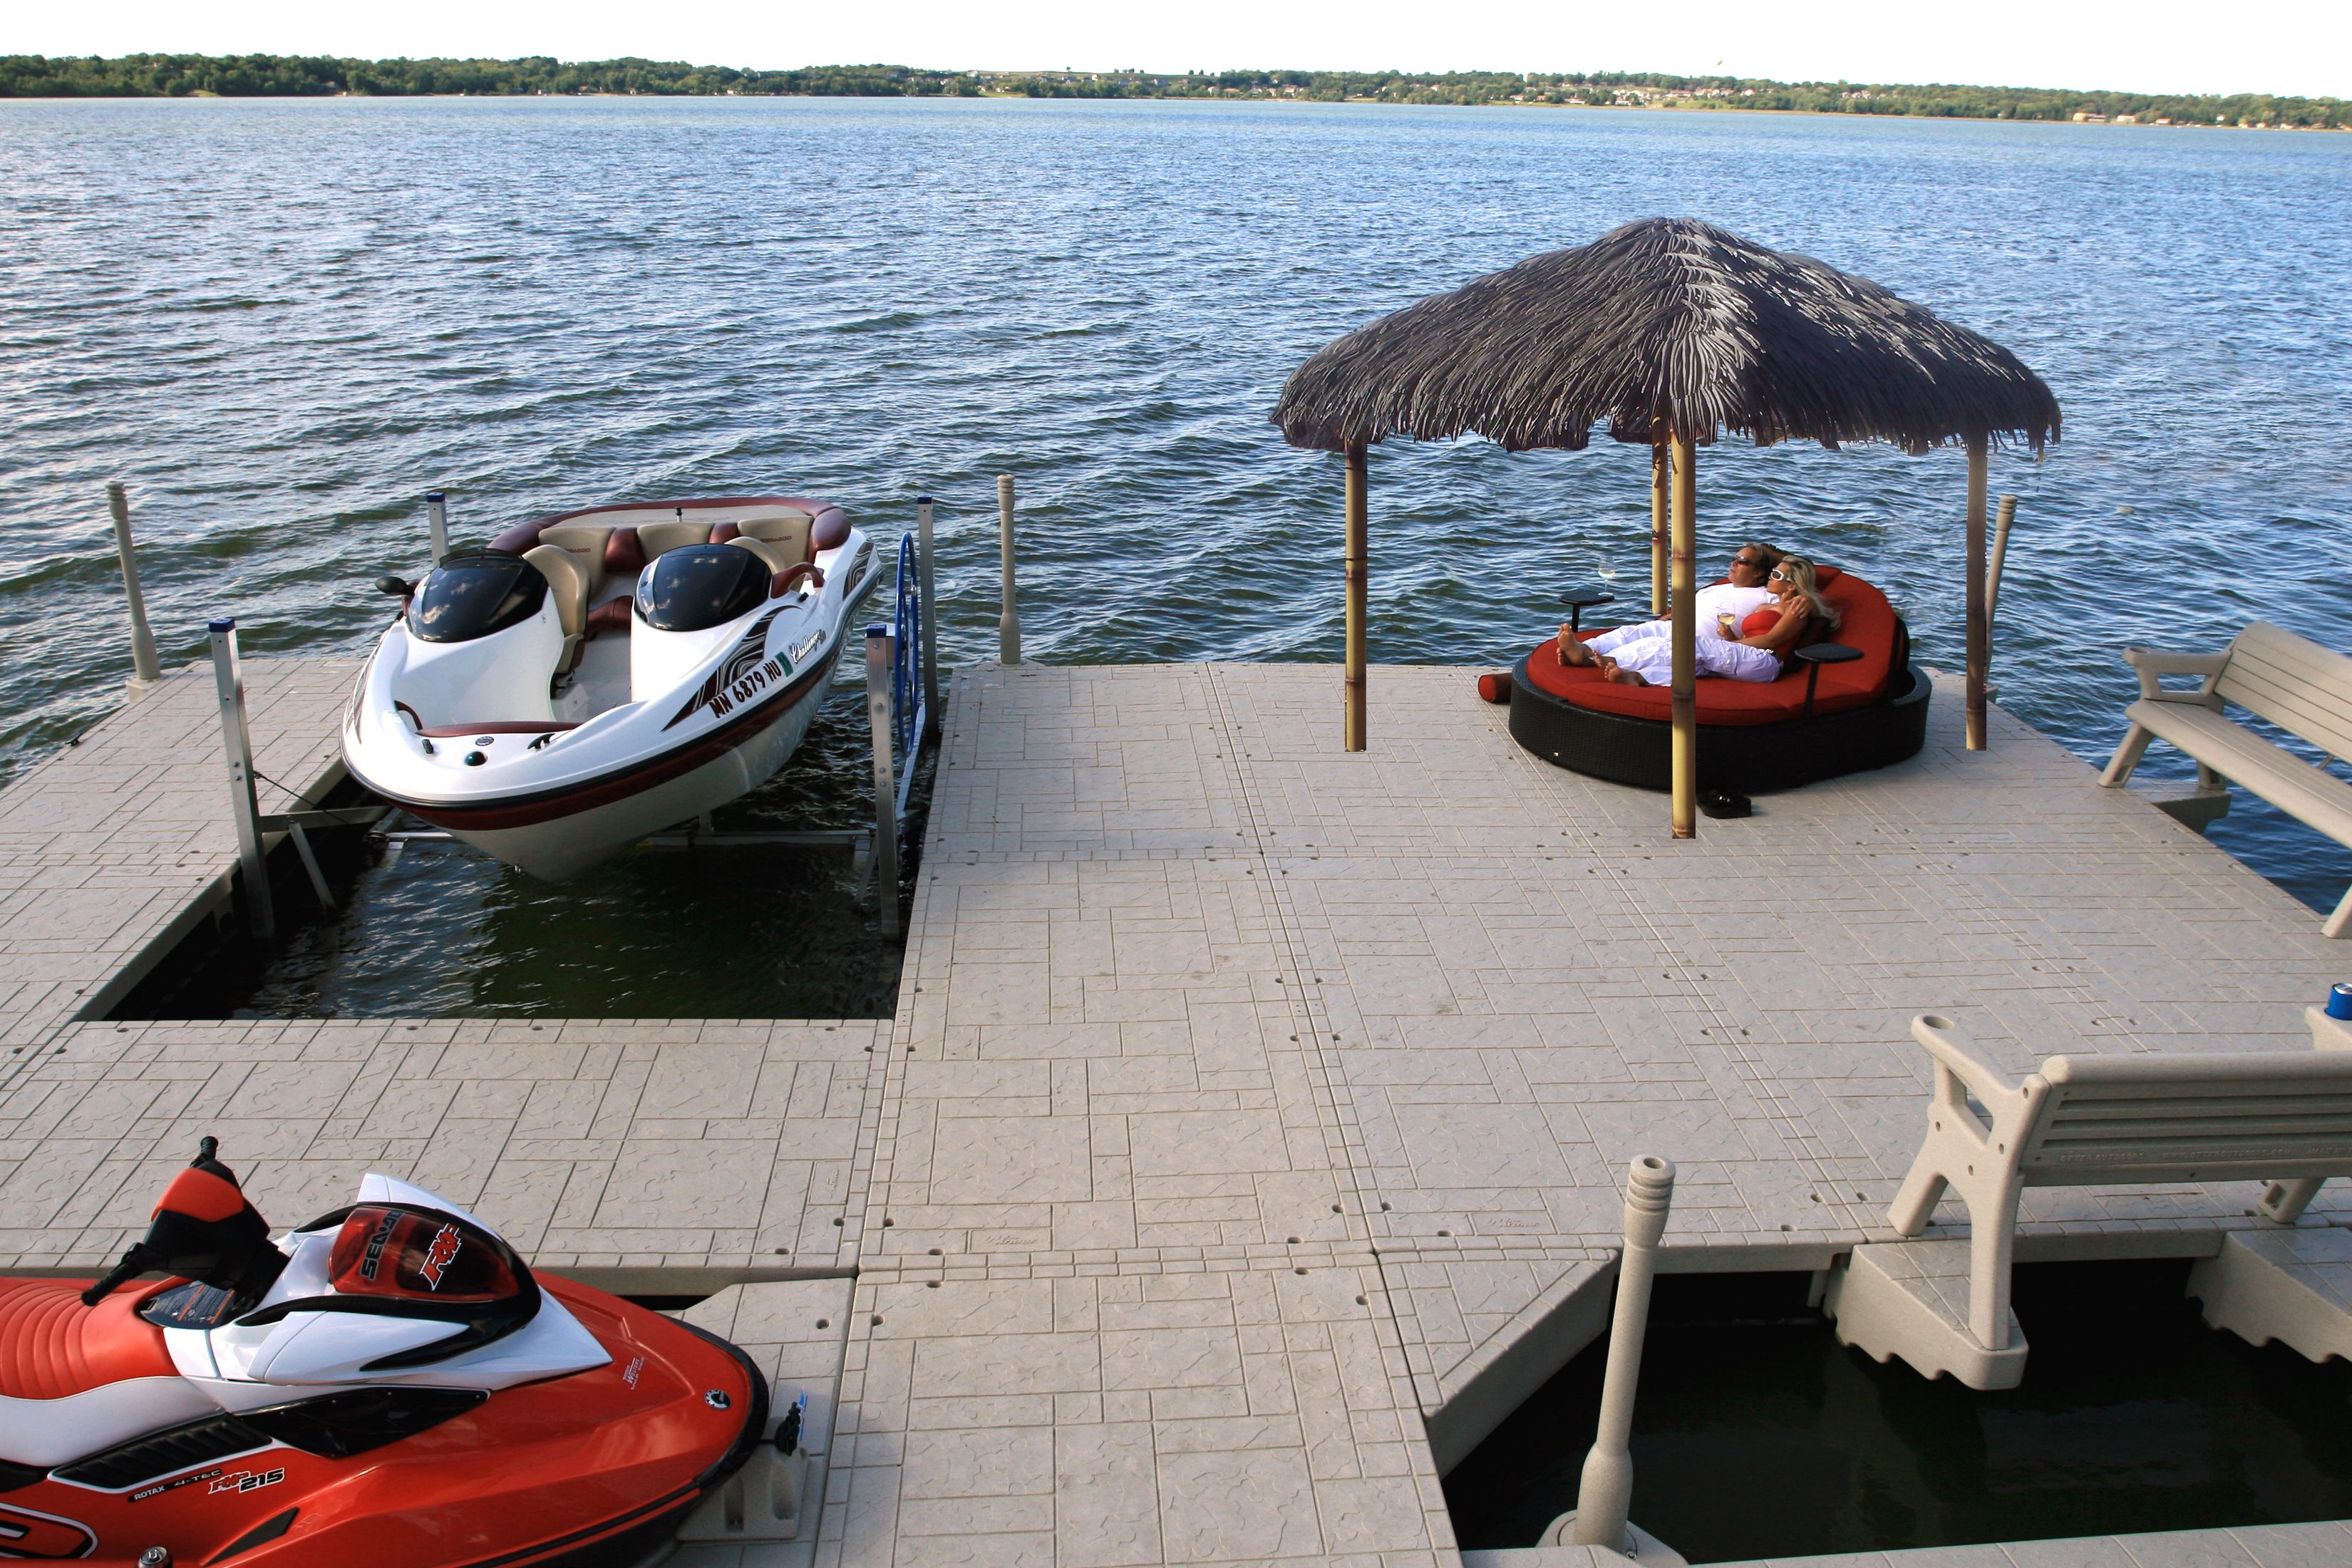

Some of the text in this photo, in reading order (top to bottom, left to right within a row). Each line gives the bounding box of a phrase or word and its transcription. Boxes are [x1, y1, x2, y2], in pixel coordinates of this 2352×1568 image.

[708, 660, 782, 718] MN 6879 HU
[134, 1470, 221, 1500] ROTAX 4-TEC
[239, 1467, 285, 1493] 215
